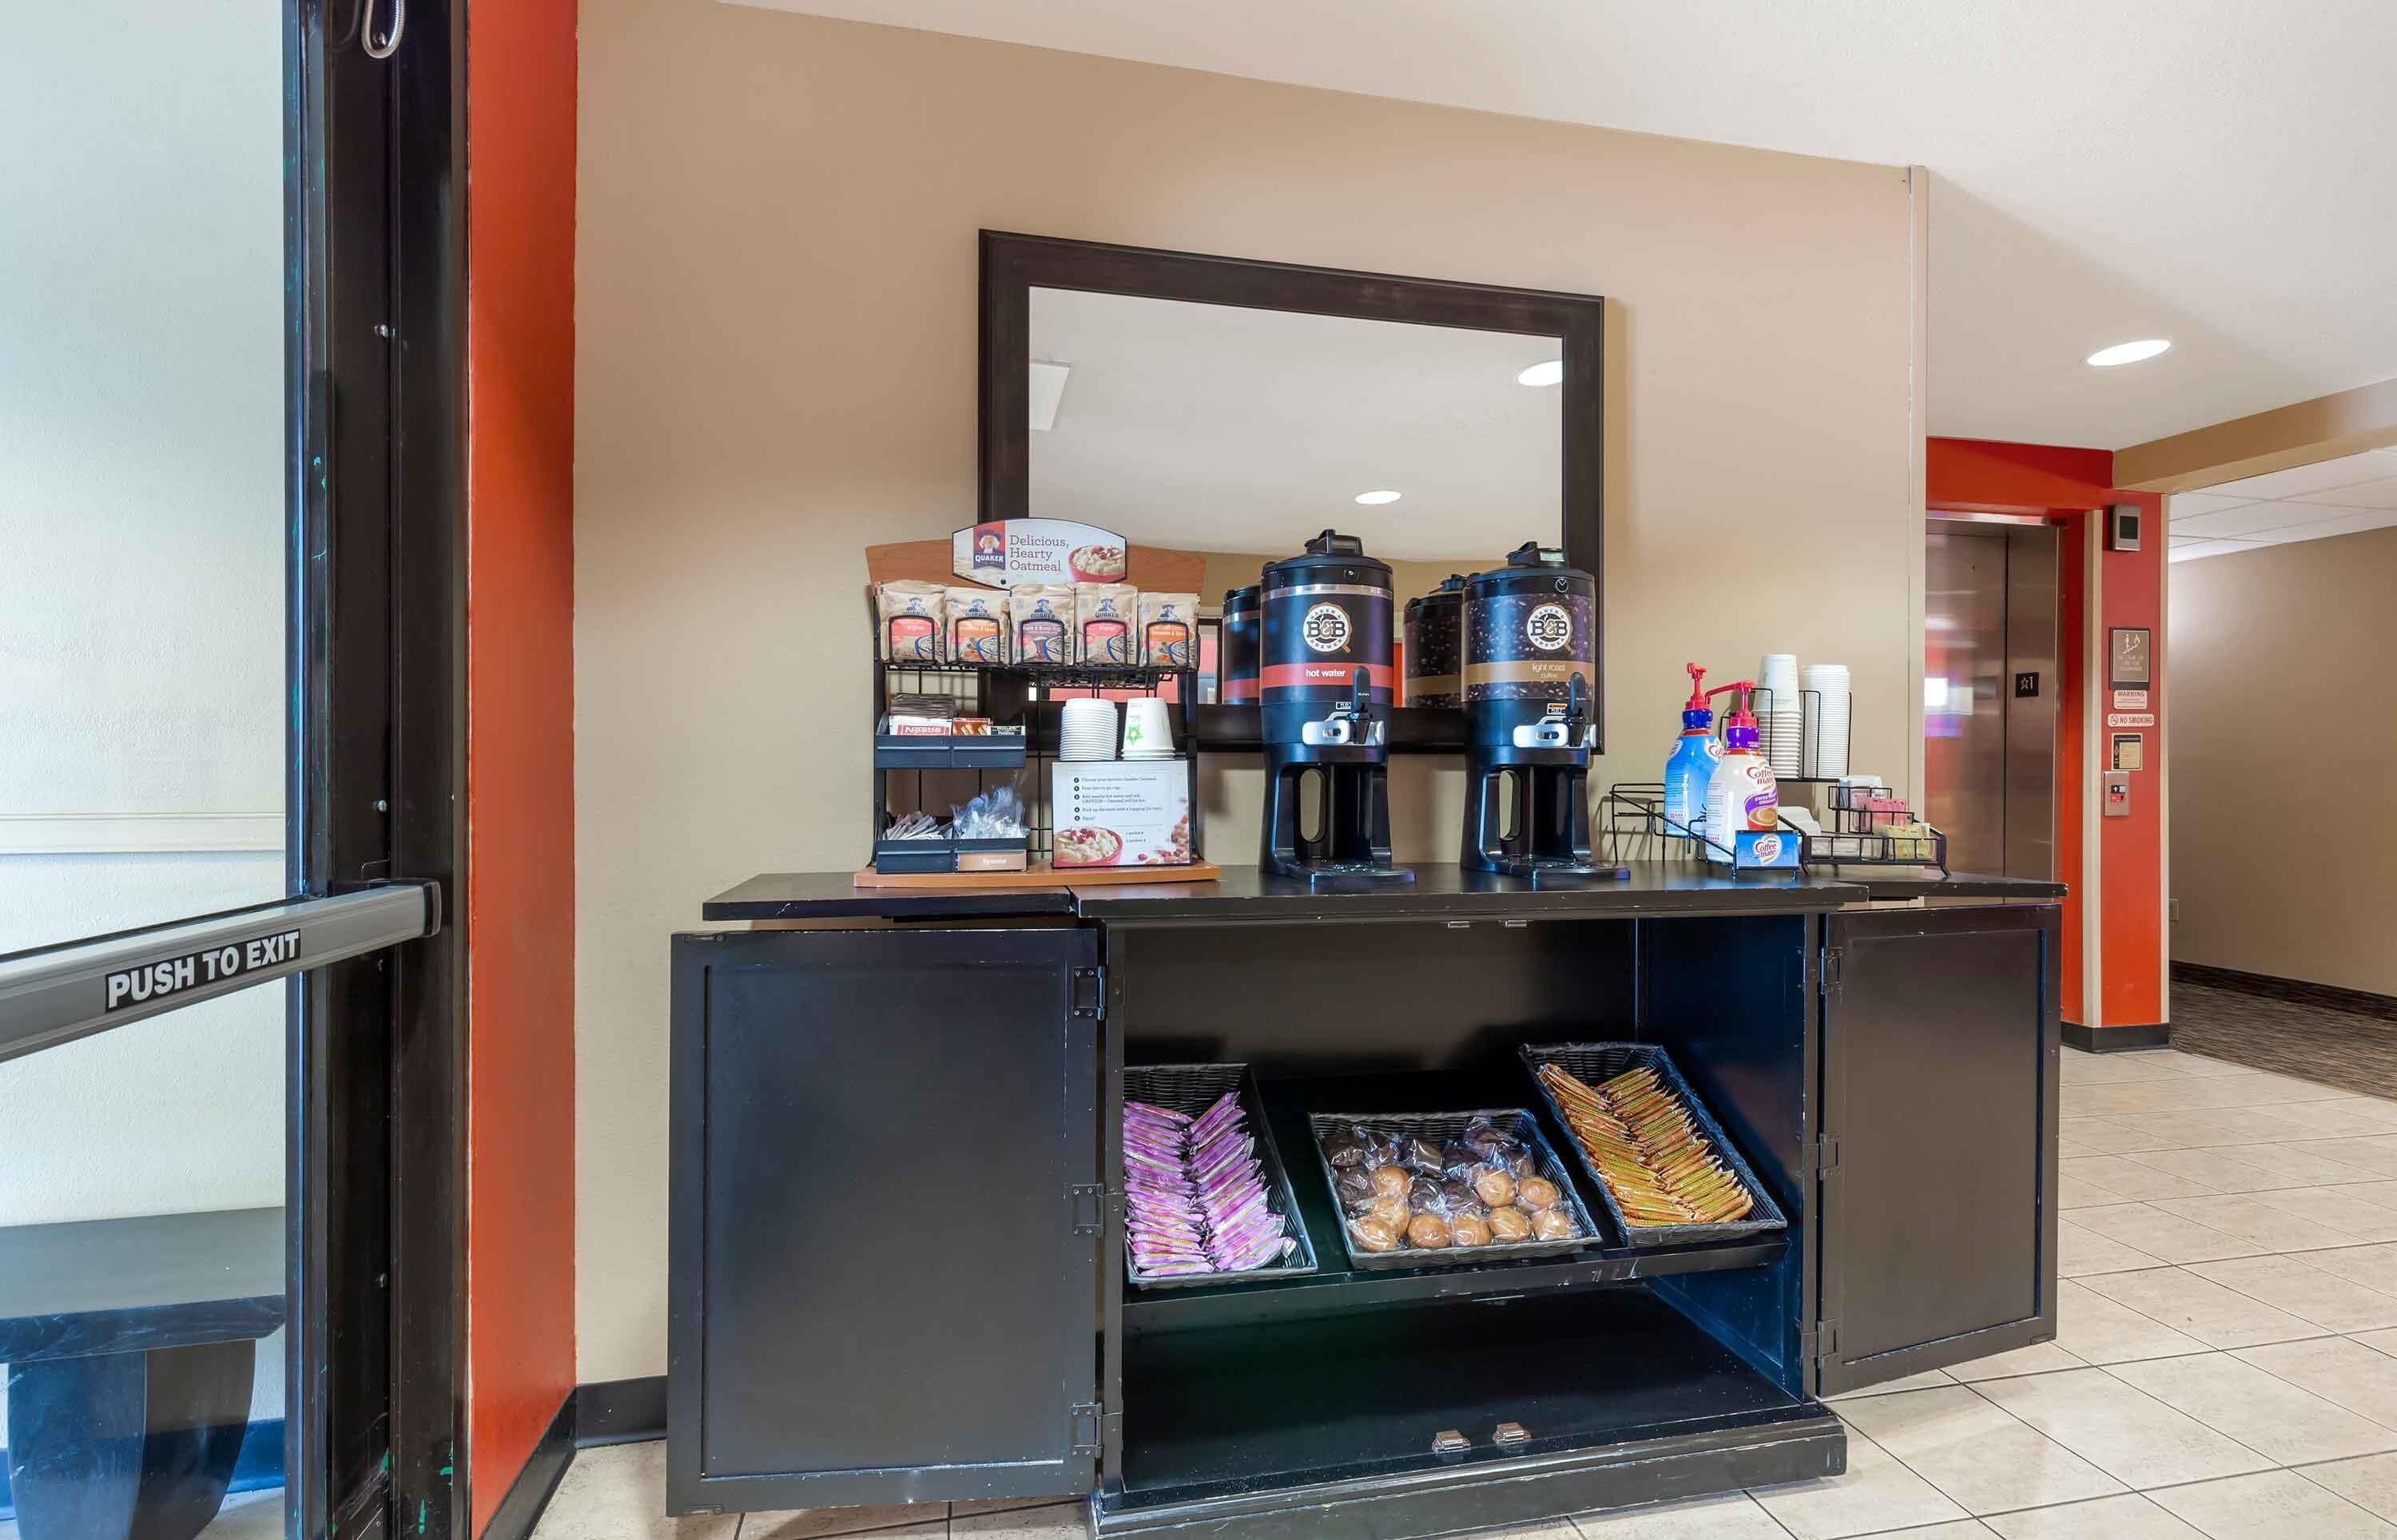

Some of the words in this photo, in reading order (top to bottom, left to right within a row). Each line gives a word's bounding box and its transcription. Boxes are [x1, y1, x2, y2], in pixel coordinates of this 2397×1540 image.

[1009, 534, 1069, 549] Delicious,
[975, 554, 1004, 563] QUAKER
[1009, 547, 1053, 561] Hearty
[1009, 558, 1061, 572] Oatmeal
[1306, 669, 1320, 677] hot
[1532, 663, 1548, 673] light
[2029, 676, 2033, 689] 1
[1747, 767, 1773, 780] Coffee
[1755, 841, 1777, 852] Coffee
[108, 957, 194, 1008] PUSH
[202, 947, 240, 979] TO
[246, 931, 299, 968] EXIT
